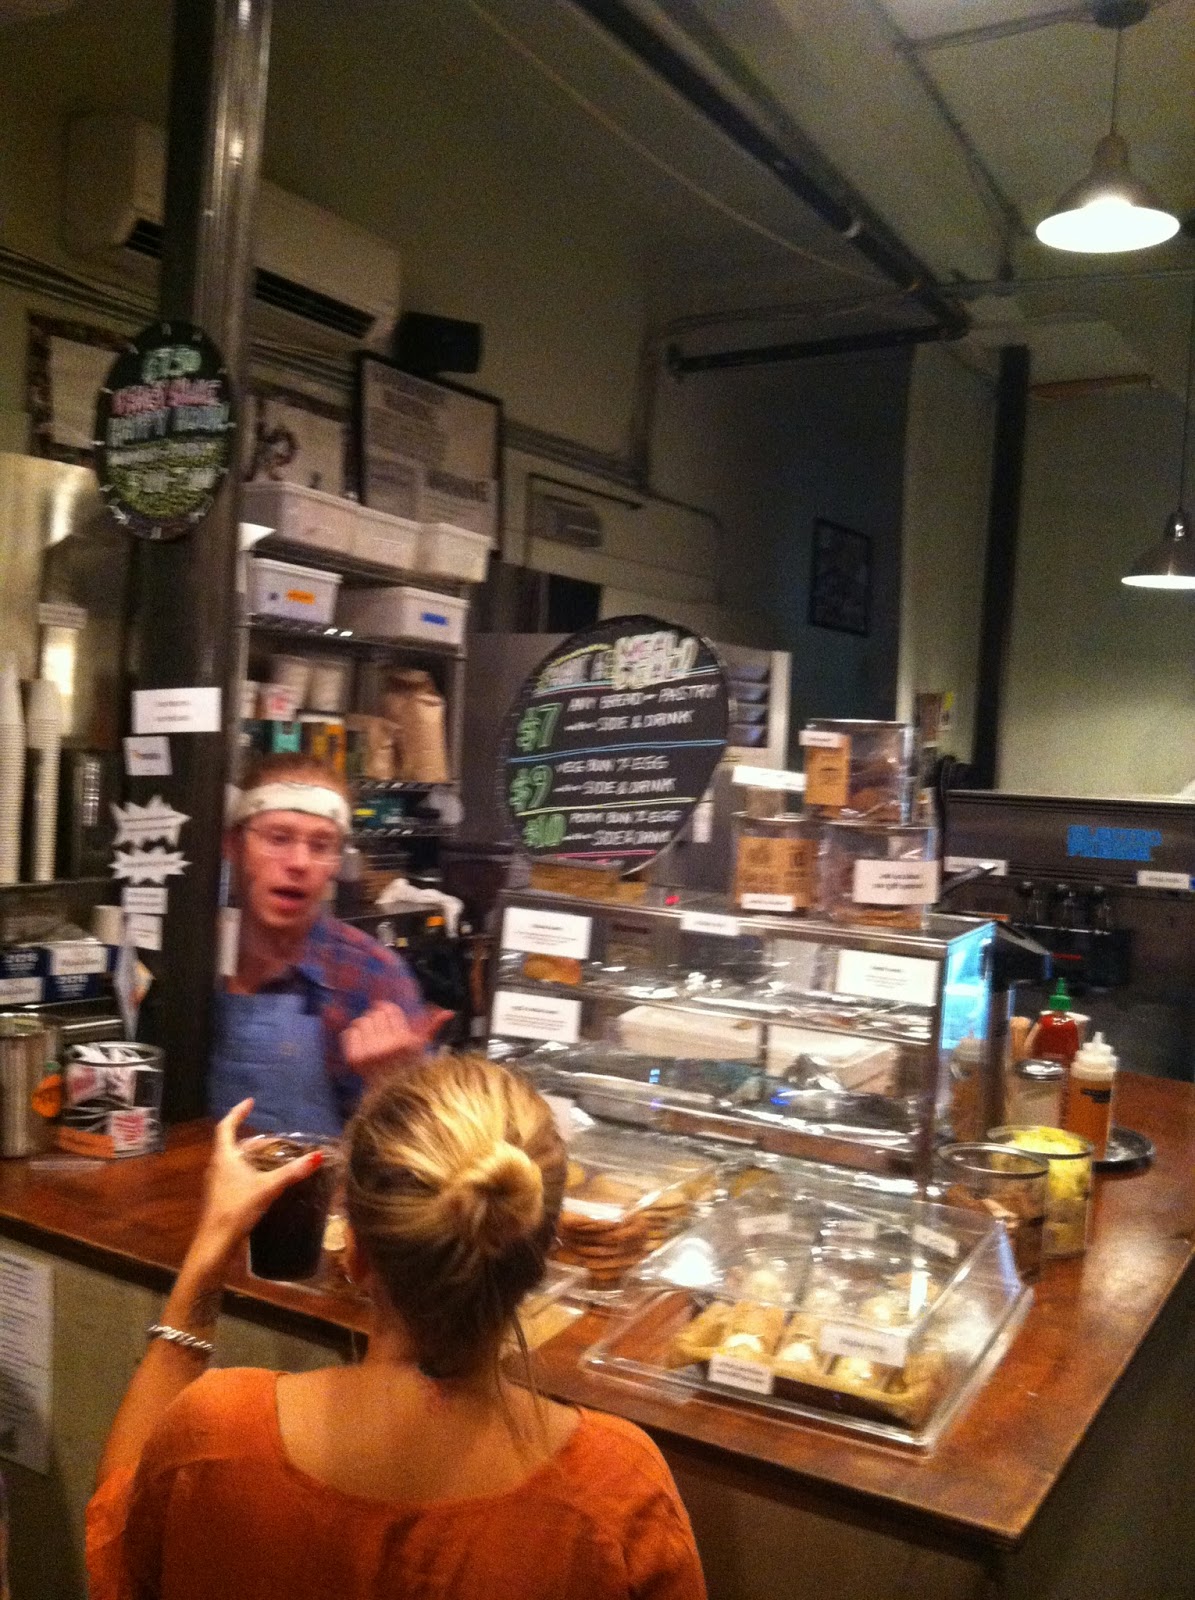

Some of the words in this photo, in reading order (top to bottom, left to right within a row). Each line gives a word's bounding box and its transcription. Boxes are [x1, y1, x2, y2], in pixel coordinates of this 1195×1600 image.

[567, 696, 598, 712] ANY
[659, 684, 721, 703] PASTRY
[516, 702, 562, 751] $7
[643, 710, 695, 727] DRINK
[509, 765, 553, 813] $9
